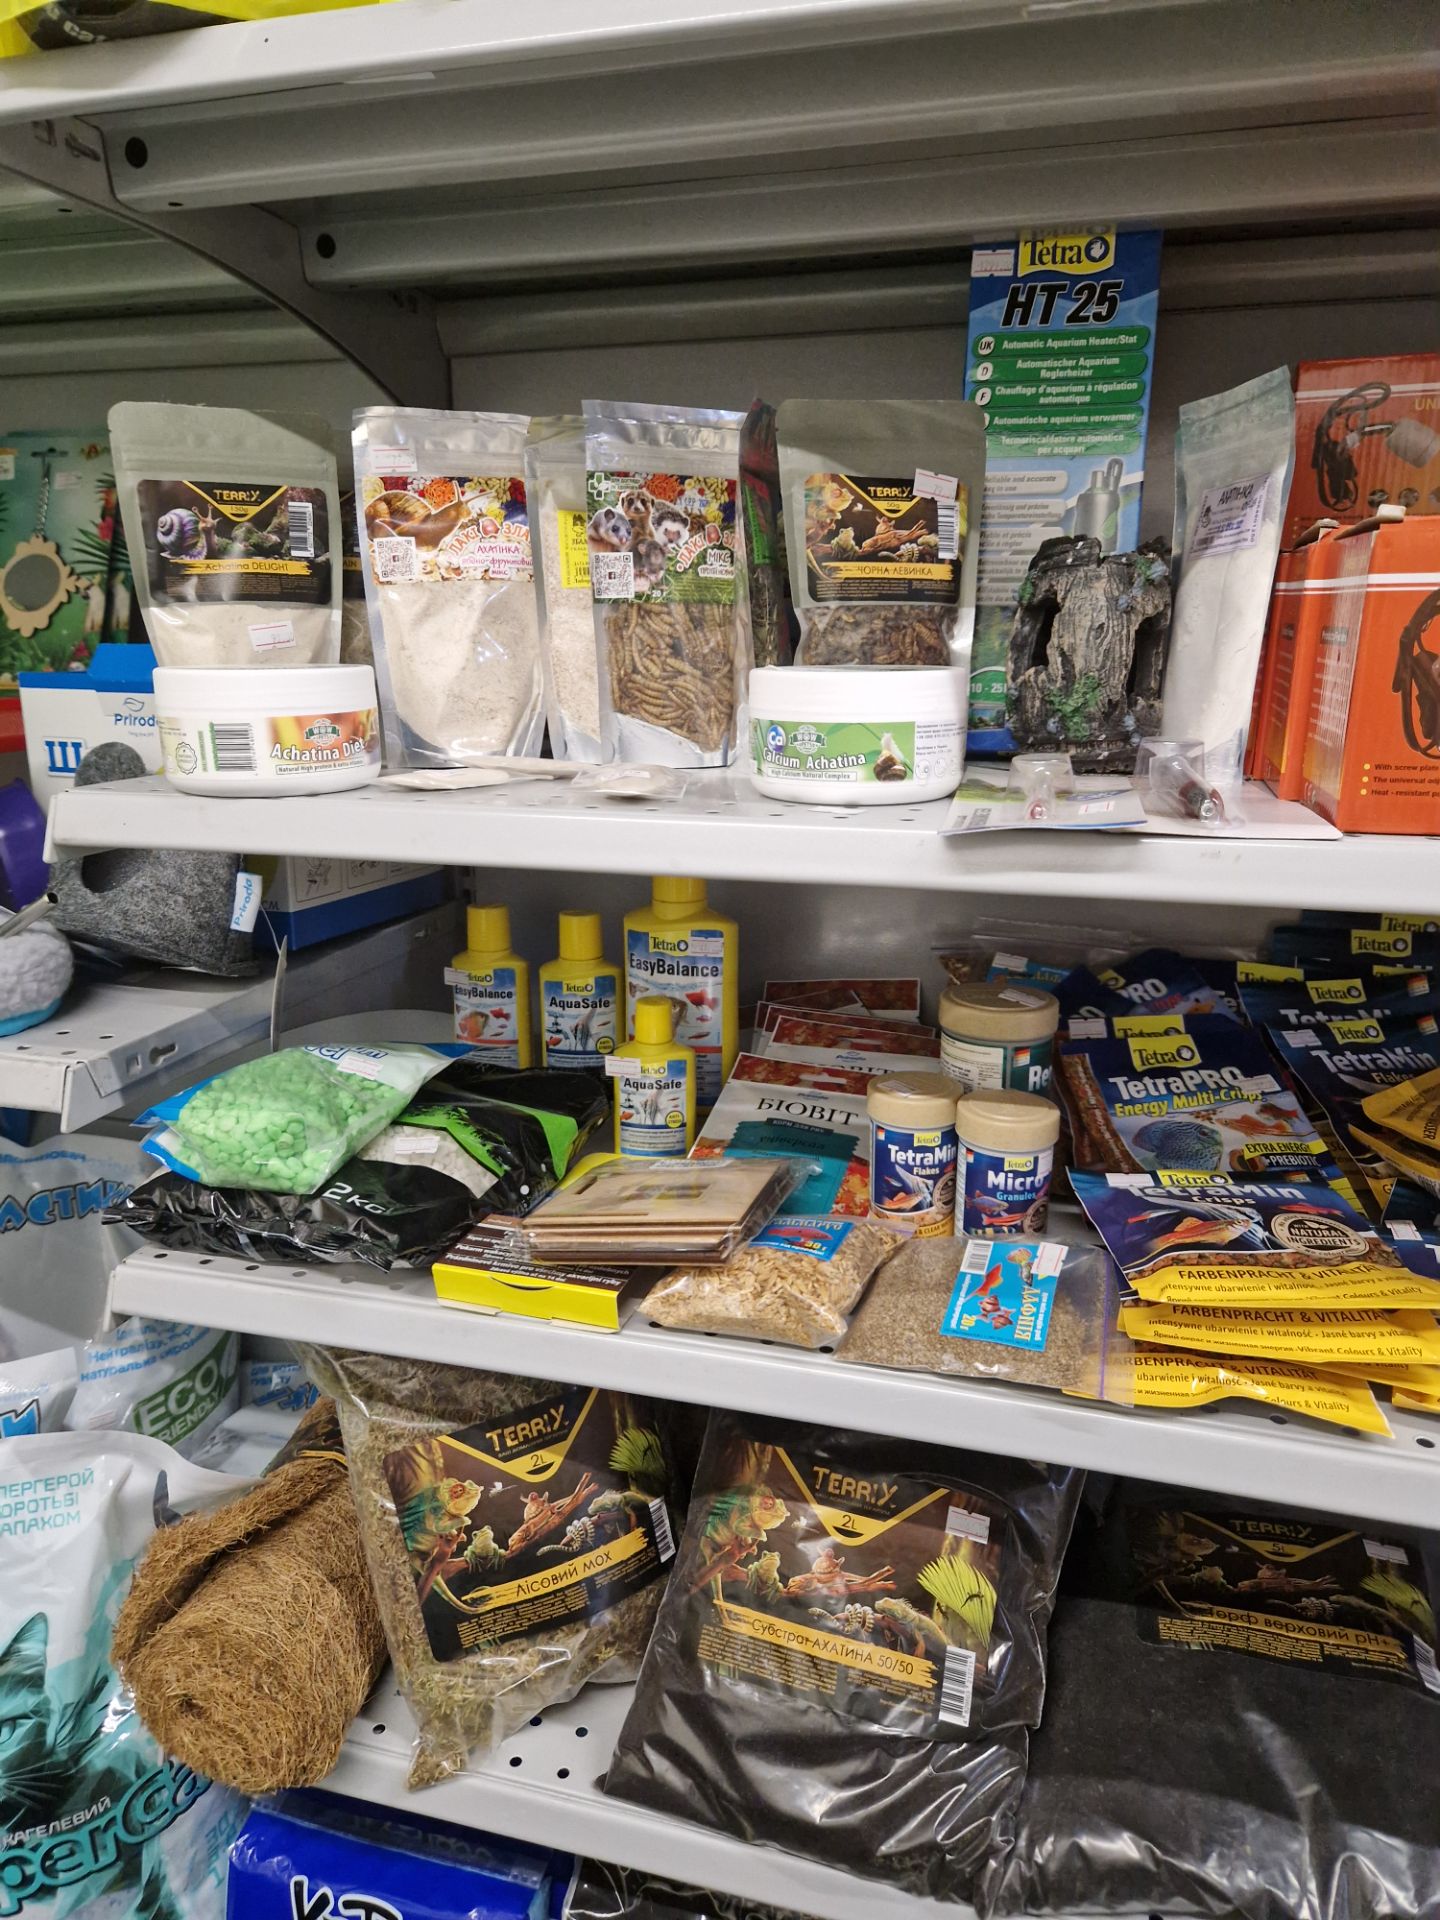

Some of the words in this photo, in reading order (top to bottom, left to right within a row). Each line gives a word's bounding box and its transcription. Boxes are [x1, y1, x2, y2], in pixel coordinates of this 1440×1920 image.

[1023, 239, 1084, 267] Tetra
[1001, 281, 1070, 329] HT
[1064, 279, 1125, 326] 25
[979, 338, 995, 353] UK
[1002, 339, 1044, 350] Automatic
[1046, 337, 1088, 350] Aquarium
[1088, 335, 1138, 346] Heater/Stat
[1016, 358, 1077, 369] Automatischer
[1078, 357, 1120, 369] Aquarium
[981, 365, 989, 378] D
[1039, 368, 1093, 380] Reglerheizer
[995, 386, 1037, 397] Chauffage
[1038, 384, 1086, 396] d'aquarium
[1094, 382, 1138, 393] régulation
[1039, 395, 1092, 406] automatique
[993, 416, 1049, 426] Automatische
[1050, 415, 1089, 425] aquarium
[1090, 413, 1136, 422] verwarmer
[476, 545, 520, 555] АХАТІНКА
[708, 550, 731, 563] МІКС
[204, 561, 250, 572] Achatina
[251, 561, 290, 573] DELIGHT
[857, 566, 889, 576] ЧОРНА
[891, 566, 933, 577] ЛЕВИНКА
[114, 713, 161, 727] Prirod
[769, 730, 784, 747] Ca
[271, 742, 340, 762] Achatina
[342, 738, 366, 758] Diet
[763, 747, 800, 769] Calcium
[806, 752, 866, 770] Achatina
[315, 763, 332, 771] protein
[1374, 763, 1392, 771] With
[783, 770, 801, 778] Calcium
[802, 771, 823, 780] Natural
[824, 773, 850, 782] Complex
[1389, 776, 1426, 784] universal
[651, 936, 678, 951] Tetra
[1354, 936, 1392, 953] Tetra
[629, 953, 719, 978] EasyBalance
[565, 983, 585, 993] Tetra
[1311, 986, 1348, 1001] Tetra
[549, 996, 611, 1011] AquaSafe
[1333, 1027, 1368, 1041] Tetra
[1134, 1049, 1178, 1068] Tetra
[1310, 1047, 1438, 1074] TetraMin
[624, 1078, 682, 1091] AquaSafe
[1108, 1066, 1247, 1100] TetraPRO
[1114, 1100, 1168, 1118] Energy
[1172, 1086, 1263, 1110] Multi-Crisps
[757, 1098, 859, 1126] БІОВІТ
[915, 1133, 934, 1144] Tetra
[1245, 1143, 1274, 1154] EXTRA
[1275, 1141, 1313, 1153] ENERGY
[913, 1167, 940, 1176] Flakes
[1007, 1160, 1026, 1170] Tetra
[987, 1170, 1044, 1191] Micro
[1162, 1173, 1209, 1187] Tetra
[996, 1191, 1036, 1202] Granules
[1110, 1183, 1307, 1200] TetraMin
[1192, 1196, 1257, 1205] Crisps
[924, 1224, 940, 1236] CLEAR
[1290, 1227, 1346, 1239] NATURAL
[1287, 1236, 1362, 1248] INGREDIENTS
[521, 1263, 535, 1273] pro
[1179, 1270, 1296, 1281] FARBENPRACHT
[1300, 1269, 1312, 1281] &
[1214, 1283, 1266, 1292] ubarwienie
[1389, 1286, 1423, 1297] Vitality
[1172, 1305, 1295, 1323] FARBENPRACHT
[1300, 1310, 1314, 1324] &
[1149, 1318, 1204, 1331] Intensywne
[1205, 1324, 1259, 1336] ubarwienie
[1267, 1326, 1313, 1338] witalność
[1321, 1329, 1347, 1339] Jasné
[1349, 1329, 1377, 1340] barvy
[1297, 1346, 1334, 1354] Vibrant
[1336, 1347, 1374, 1357] Colours
[1376, 1348, 1387, 1357] &
[1386, 1346, 1423, 1357] Vitality
[1136, 1373, 1190, 1382] ubarwienie
[1278, 1382, 1306, 1392] barvy
[137, 1358, 220, 1435] ECO
[1314, 1400, 1350, 1412] Vitality
[160, 1388, 223, 1442] RIENDLY
[530, 1454, 547, 1467] 2L
[841, 1514, 857, 1530] 2L
[1202, 1607, 1259, 1626] Торф
[1264, 1618, 1350, 1641] верховий
[877, 1654, 915, 1676] 50/50
